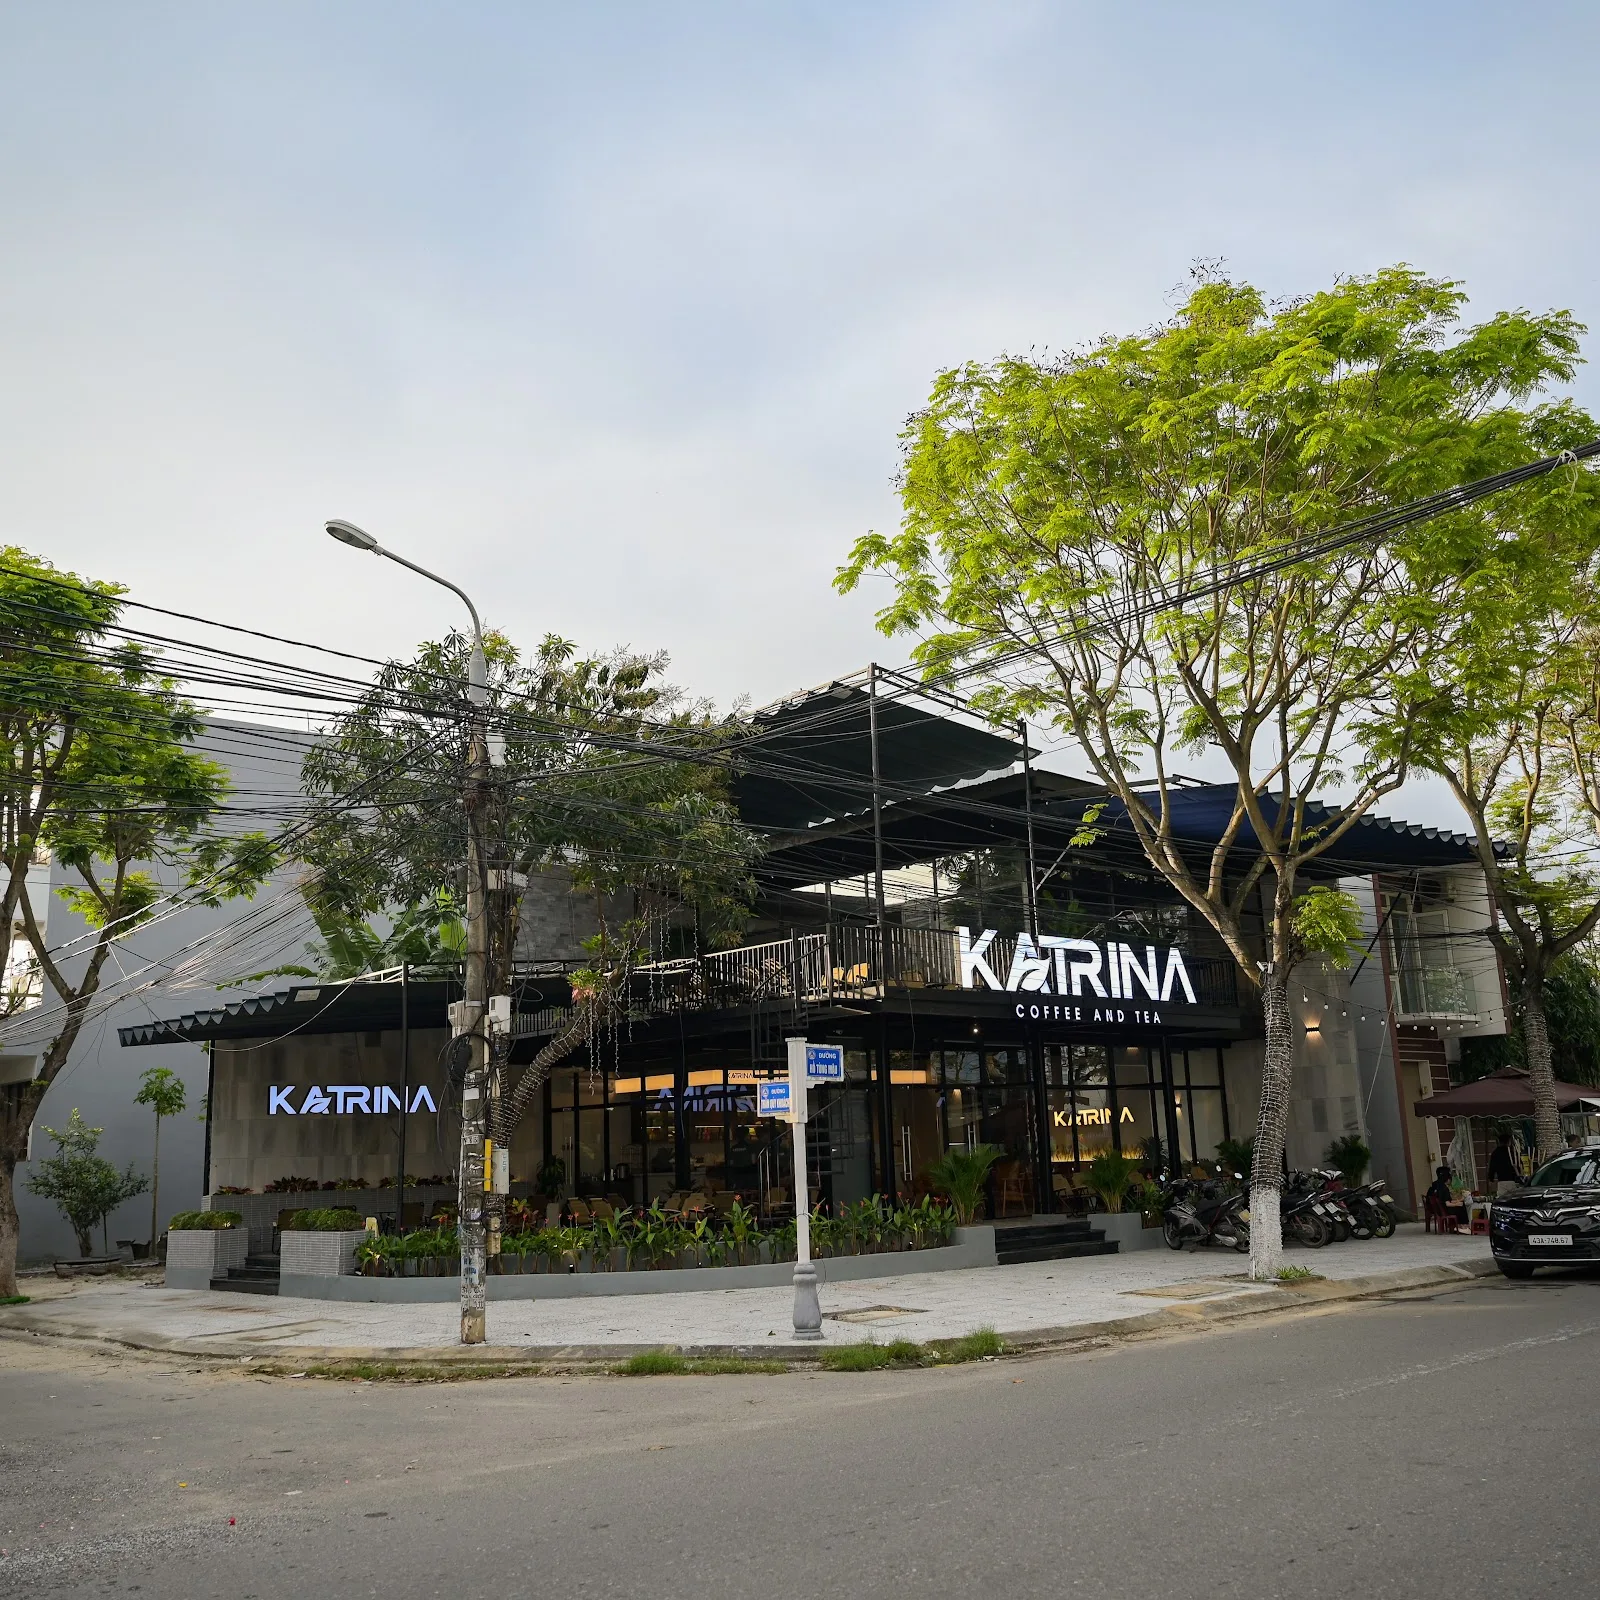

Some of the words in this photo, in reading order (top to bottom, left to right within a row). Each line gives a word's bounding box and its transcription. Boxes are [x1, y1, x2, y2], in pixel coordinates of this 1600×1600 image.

[958, 926, 1197, 1004] KATRINA
[1015, 1004, 1081, 1021] COFFEE
[1094, 1009, 1125, 1023] AND
[1135, 1010, 1161, 1024] TEA
[269, 1085, 437, 1115] KATRINA
